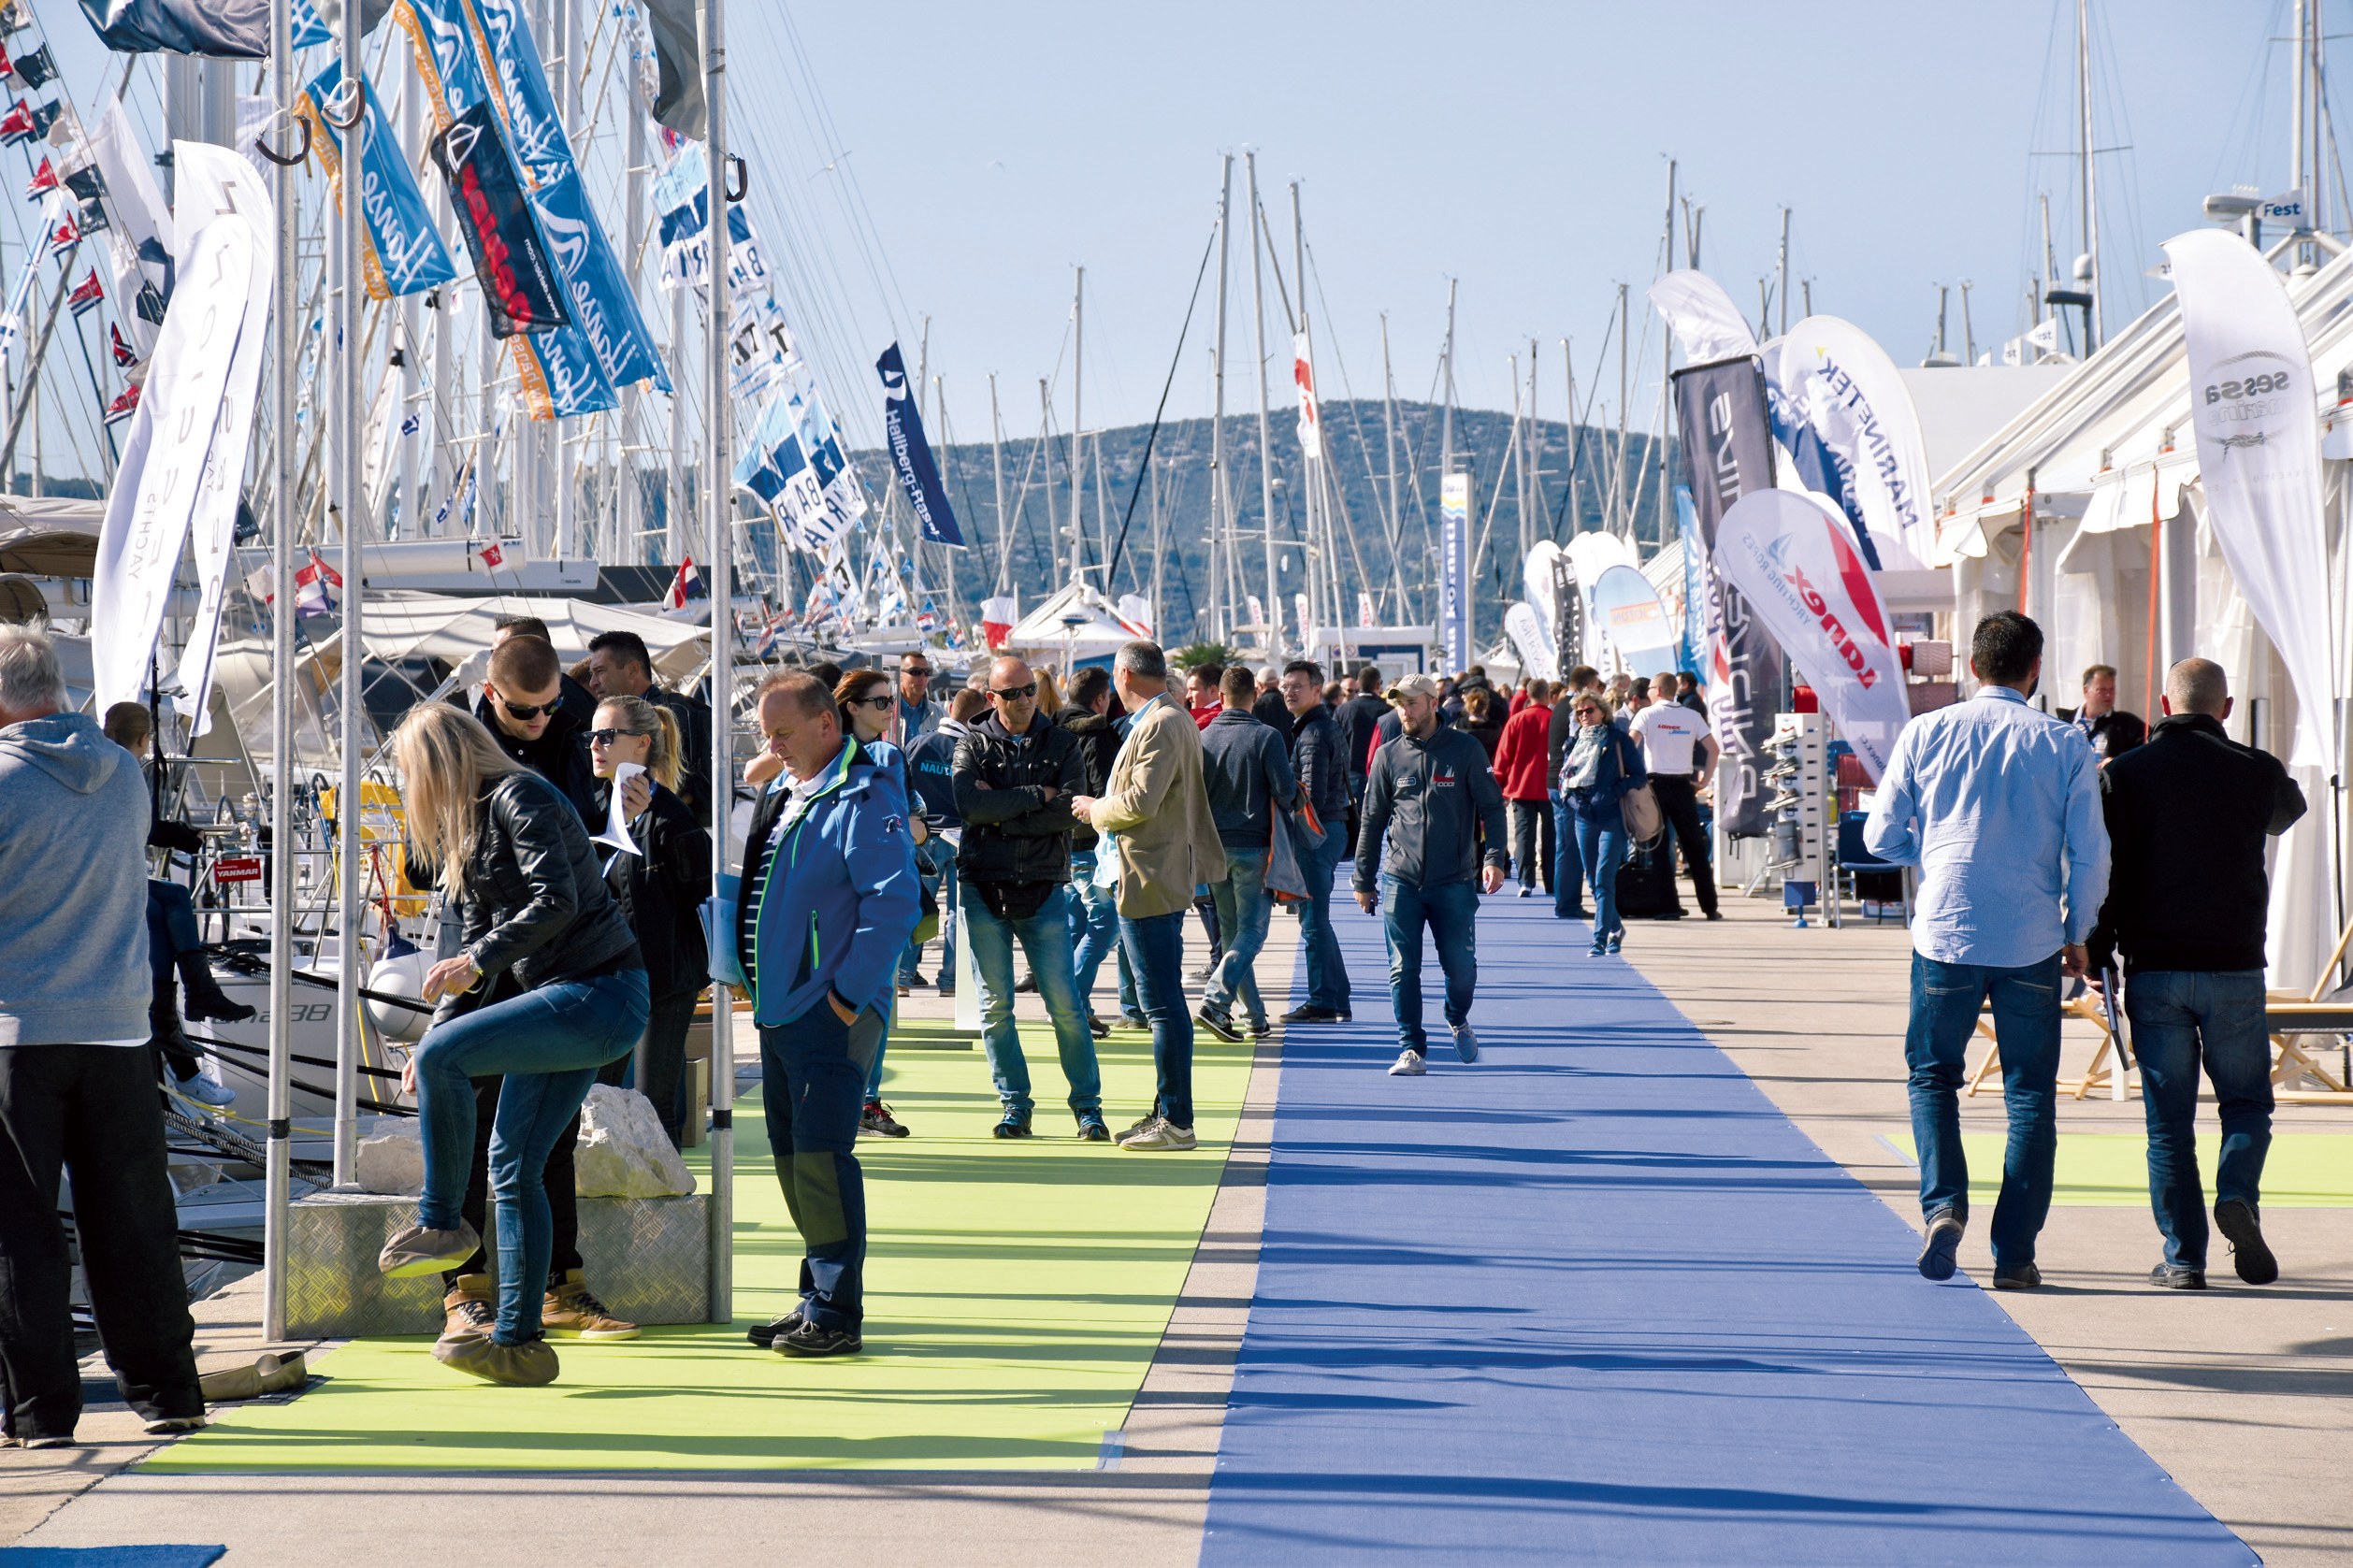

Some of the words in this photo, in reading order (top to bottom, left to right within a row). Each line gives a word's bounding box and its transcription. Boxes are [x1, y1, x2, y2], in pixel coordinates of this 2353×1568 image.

[2263, 202, 2302, 217] Fest
[1445, 523, 1458, 621] kornati
[920, 762, 953, 777] NAUTI
[216, 868, 259, 878] YANMAR
[289, 1003, 333, 1022] 38
